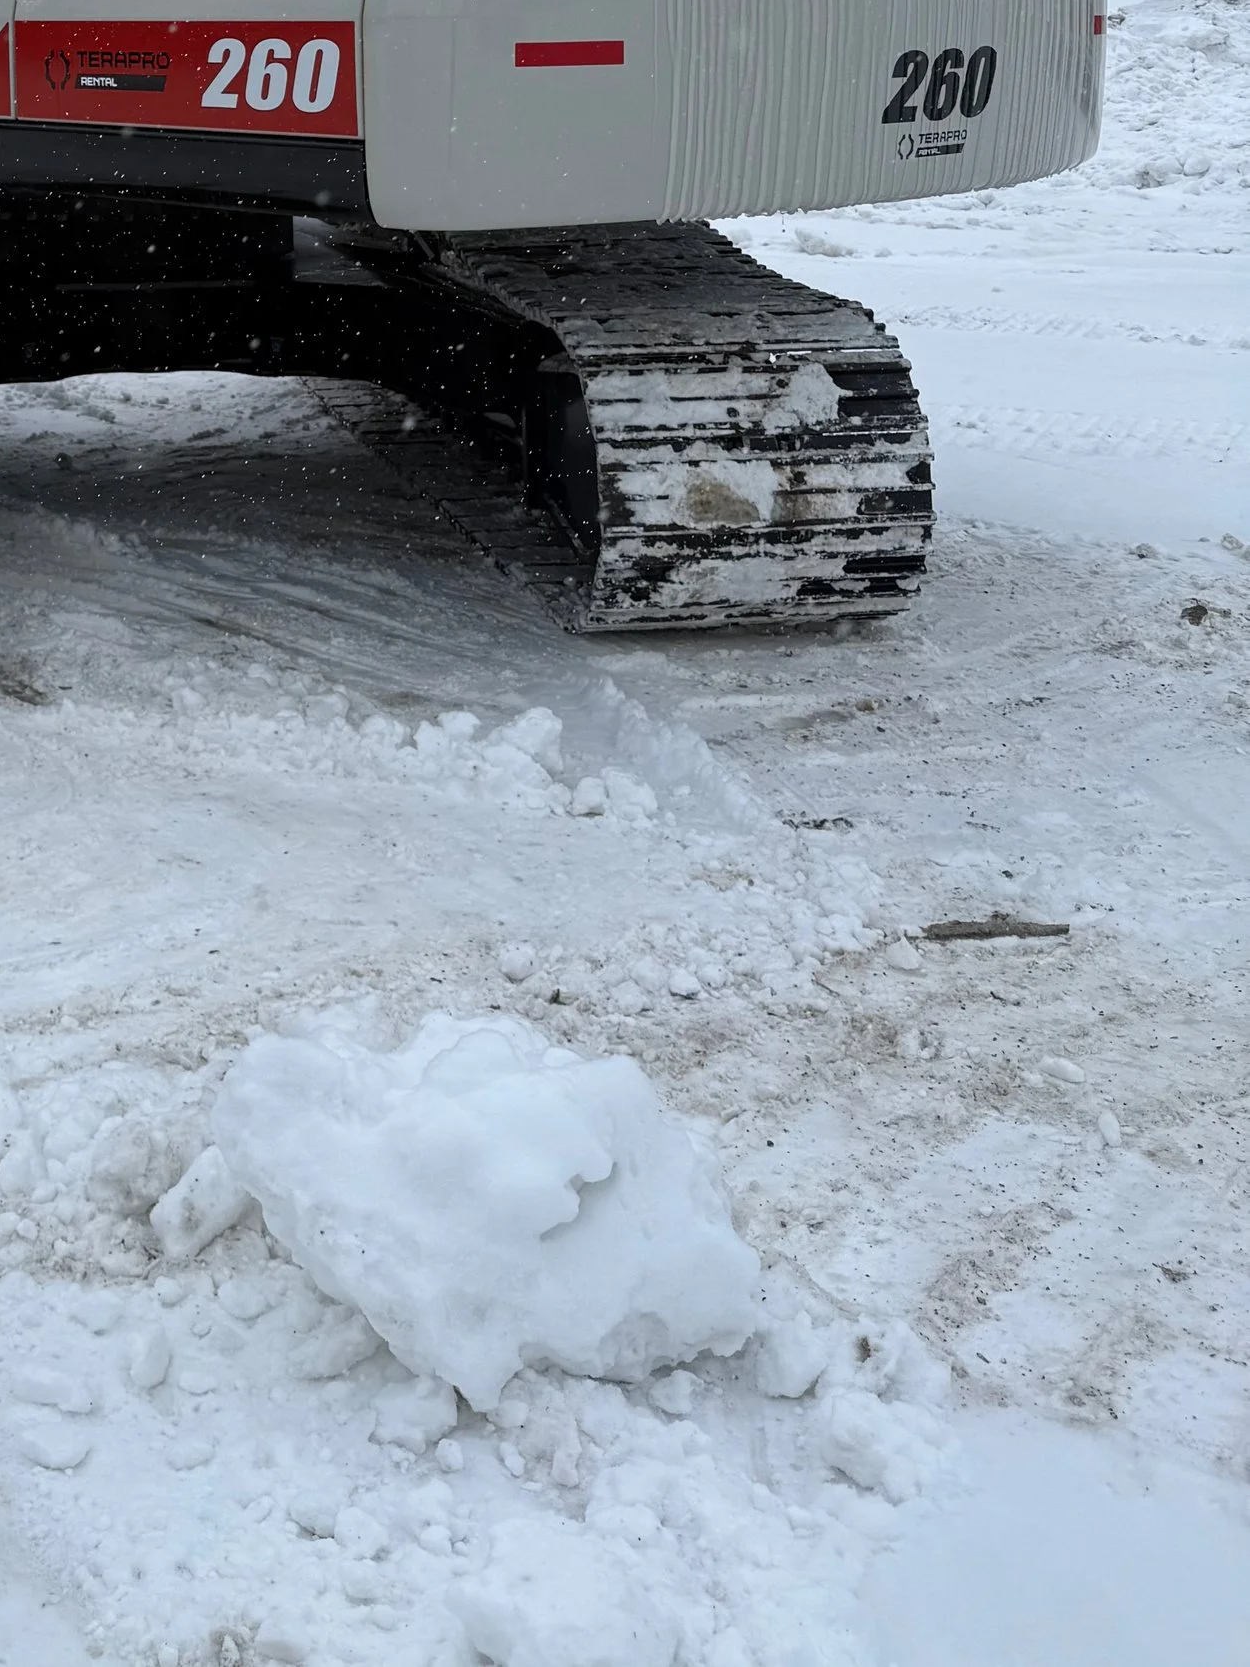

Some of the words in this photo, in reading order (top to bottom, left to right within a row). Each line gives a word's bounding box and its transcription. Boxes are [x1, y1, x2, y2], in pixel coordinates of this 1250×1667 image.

[76, 50, 171, 70] TERAPRO
[80, 76, 118, 88] RENTAL
[200, 37, 341, 113] 260
[881, 45, 997, 125] 260
[918, 129, 968, 145] TERAPRO
